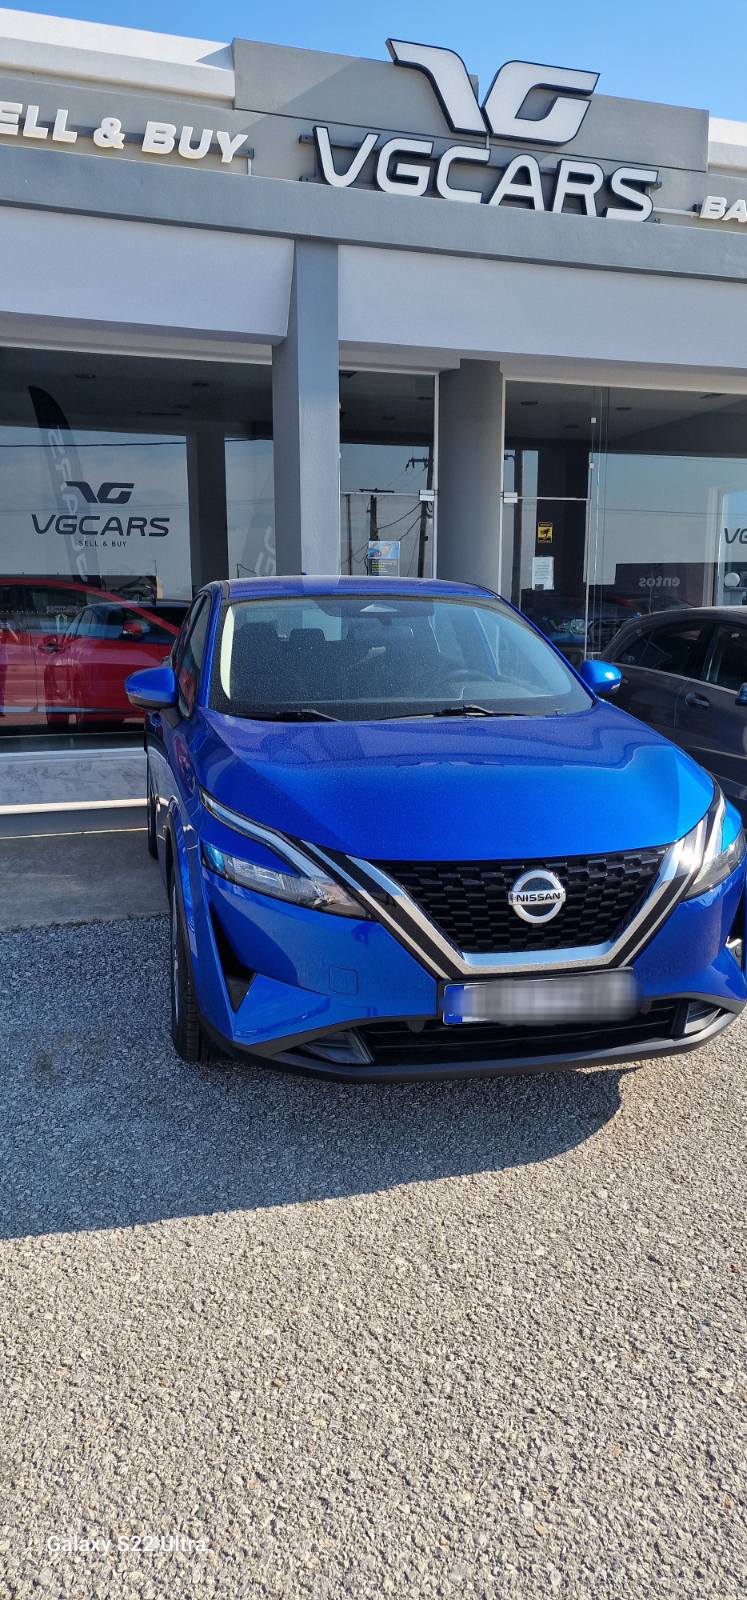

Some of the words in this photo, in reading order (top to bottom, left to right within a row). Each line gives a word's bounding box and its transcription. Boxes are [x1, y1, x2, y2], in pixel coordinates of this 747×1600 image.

[93, 117, 125, 149] &
[141, 121, 248, 163] BUY
[312, 126, 660, 222] VGCARS
[700, 195, 747, 222] BA
[31, 513, 170, 537] VGCARS
[78, 540, 100, 548] SELL
[111, 540, 127, 548] BUY
[516, 892, 561, 902] NISSAN
